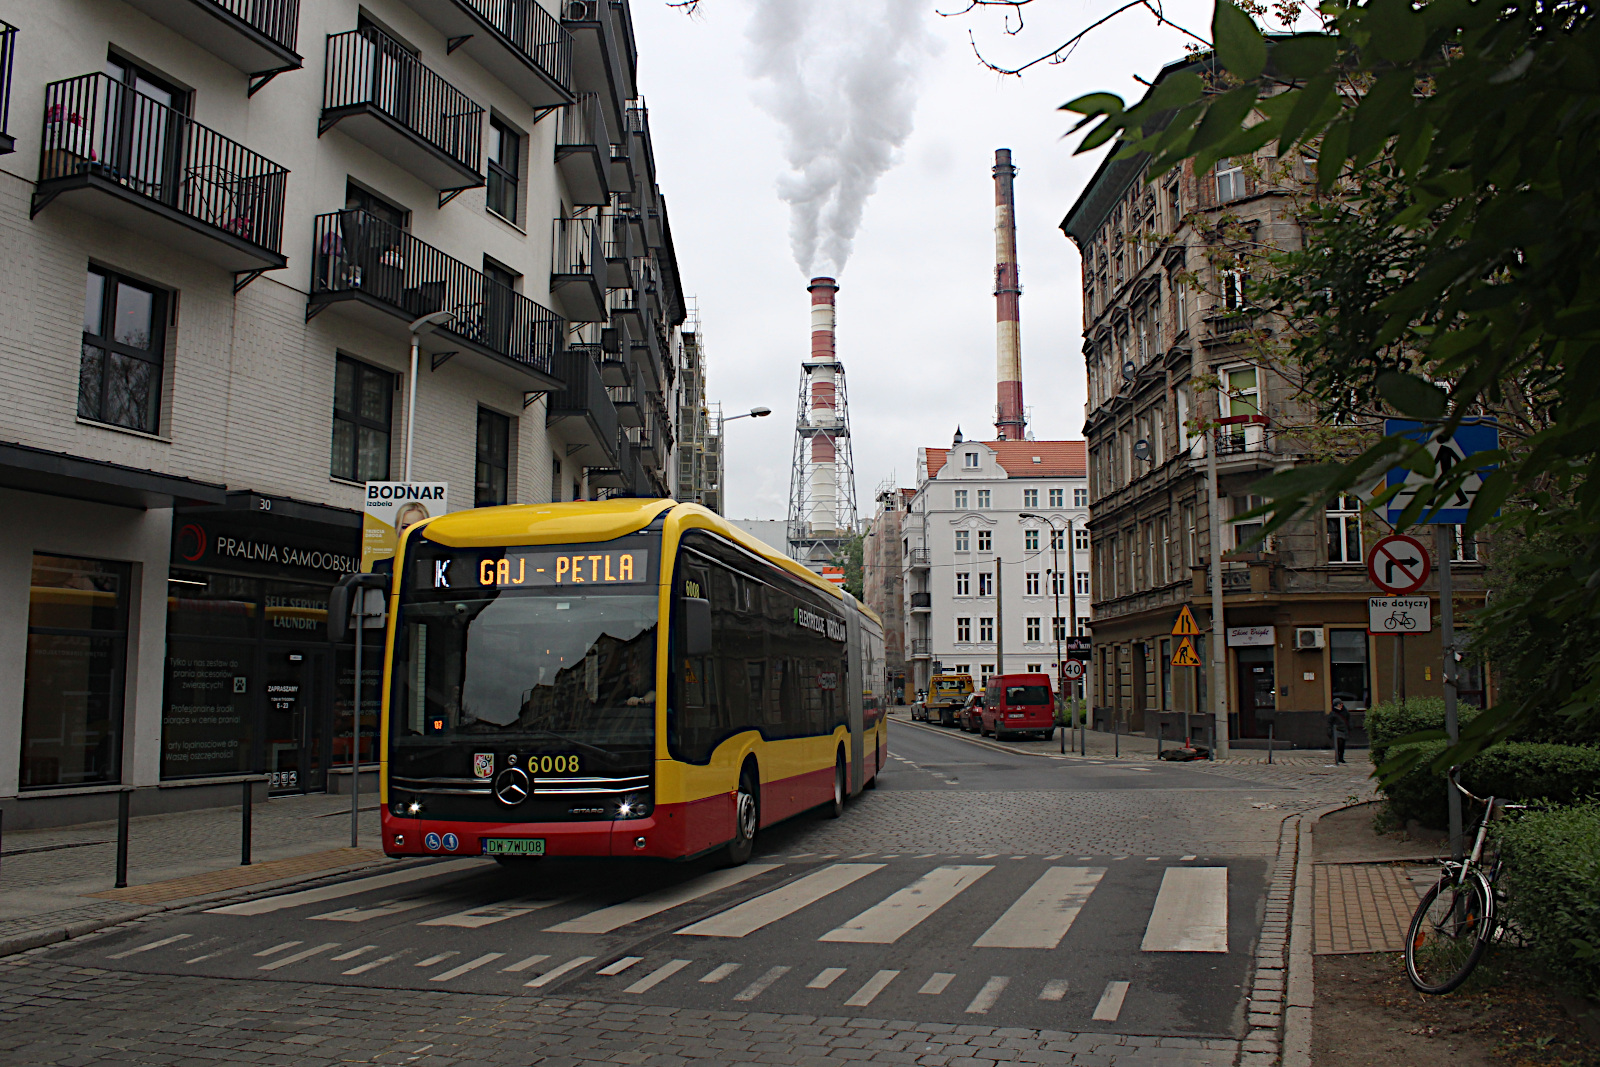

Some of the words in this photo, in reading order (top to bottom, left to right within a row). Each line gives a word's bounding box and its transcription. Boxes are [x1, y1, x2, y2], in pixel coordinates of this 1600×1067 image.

[368, 486, 444, 500] BODNAR
[260, 499, 271, 511] 30
[217, 536, 279, 563] PRALNIA
[281, 546, 361, 575] SAMOOBSŁU
[434, 559, 450, 588] K
[479, 558, 525, 586] GAJ
[556, 553, 634, 583] PĘTLA
[685, 580, 700, 599] 6008
[265, 595, 287, 607] SELF
[290, 597, 328, 610] SERVICE
[1371, 599, 1388, 608] Nie
[1391, 599, 1428, 609] dotyczy
[273, 615, 318, 630] LAUNDRY
[1232, 629, 1248, 637] Shine
[1250, 628, 1269, 637] Bright
[170, 657, 187, 667] Tylko
[193, 659, 206, 667] nas
[206, 658, 229, 668] zestaw
[229, 659, 238, 668] do
[173, 669, 196, 679] prania
[196, 669, 233, 679] akcesoriów
[1065, 664, 1081, 675] 40
[267, 685, 299, 693] ZAPRASZAMY
[171, 703, 215, 714] Profesjonalne
[198, 715, 217, 724] cenie
[227, 739, 238, 748] dla
[165, 753, 189, 763] Waszej
[528, 755, 580, 774] 6008
[489, 840, 503, 852] DW
[507, 840, 542, 852] 7WU08
